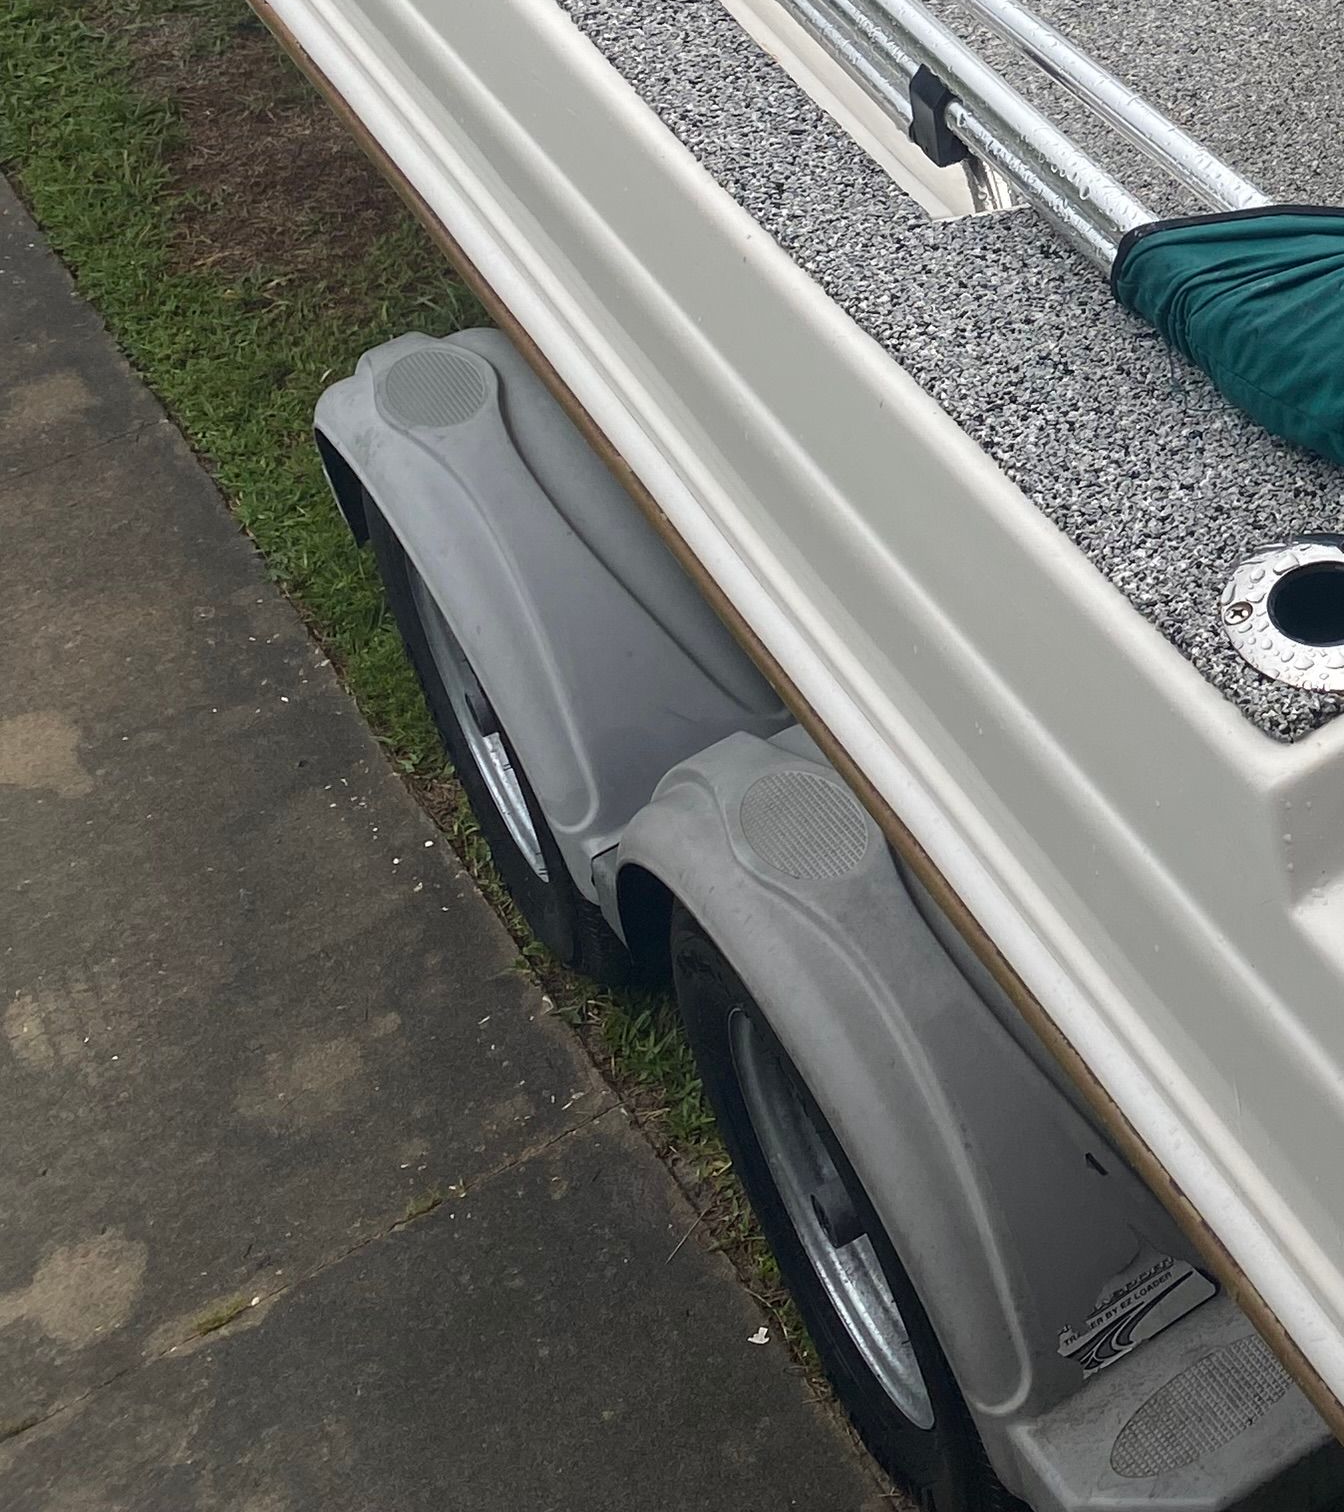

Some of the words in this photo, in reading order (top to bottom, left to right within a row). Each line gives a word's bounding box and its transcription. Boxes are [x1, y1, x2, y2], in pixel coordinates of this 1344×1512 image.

[1105, 1307, 1119, 1320] BY
[1120, 1296, 1132, 1310] EZ
[1133, 1271, 1173, 1300] LOADER
